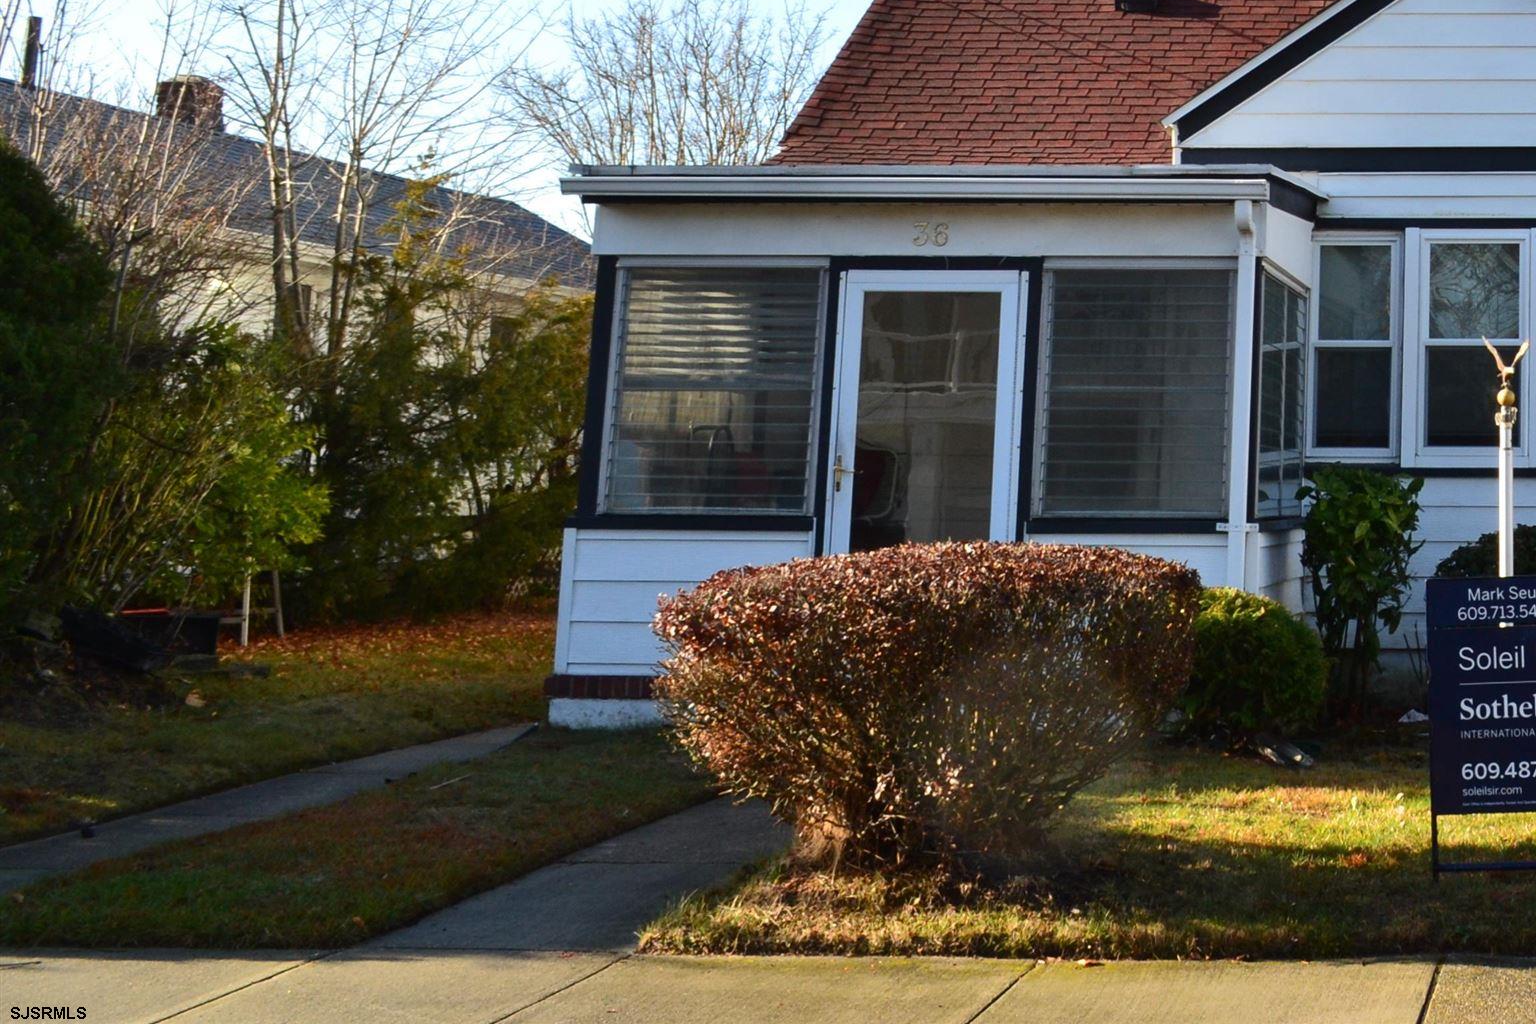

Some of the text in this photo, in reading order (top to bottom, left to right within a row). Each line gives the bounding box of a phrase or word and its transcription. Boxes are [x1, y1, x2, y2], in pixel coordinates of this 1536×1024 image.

[912, 221, 949, 247] 36
[1467, 587, 1505, 602] Mark
[1458, 645, 1525, 671] Soleil
[1462, 785, 1523, 797] soleilsir.com
